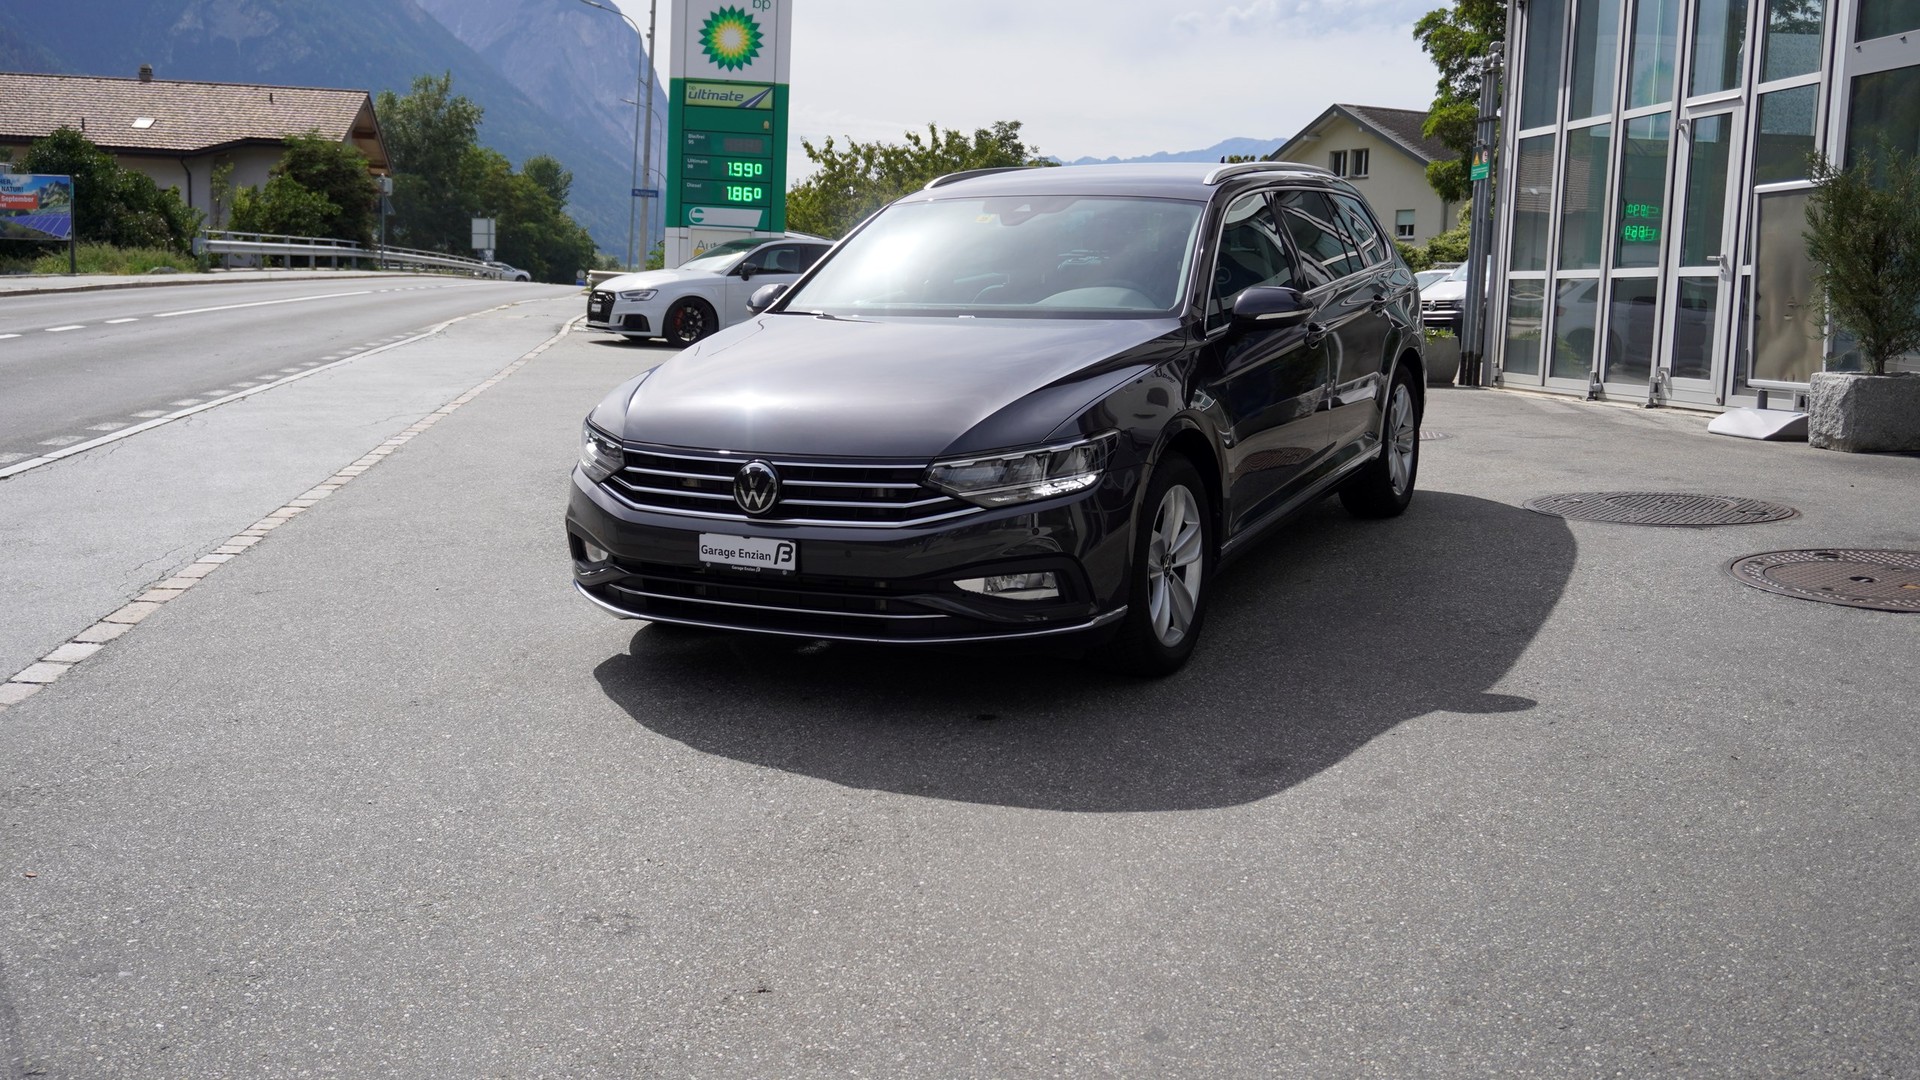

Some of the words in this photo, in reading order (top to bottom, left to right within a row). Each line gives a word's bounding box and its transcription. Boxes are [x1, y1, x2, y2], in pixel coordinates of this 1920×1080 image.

[753, 0, 770, 12] bp
[688, 88, 744, 102] ultimate
[1, 195, 34, 203] September
[701, 545, 736, 559] Garage
[738, 548, 771, 561] Enzian
